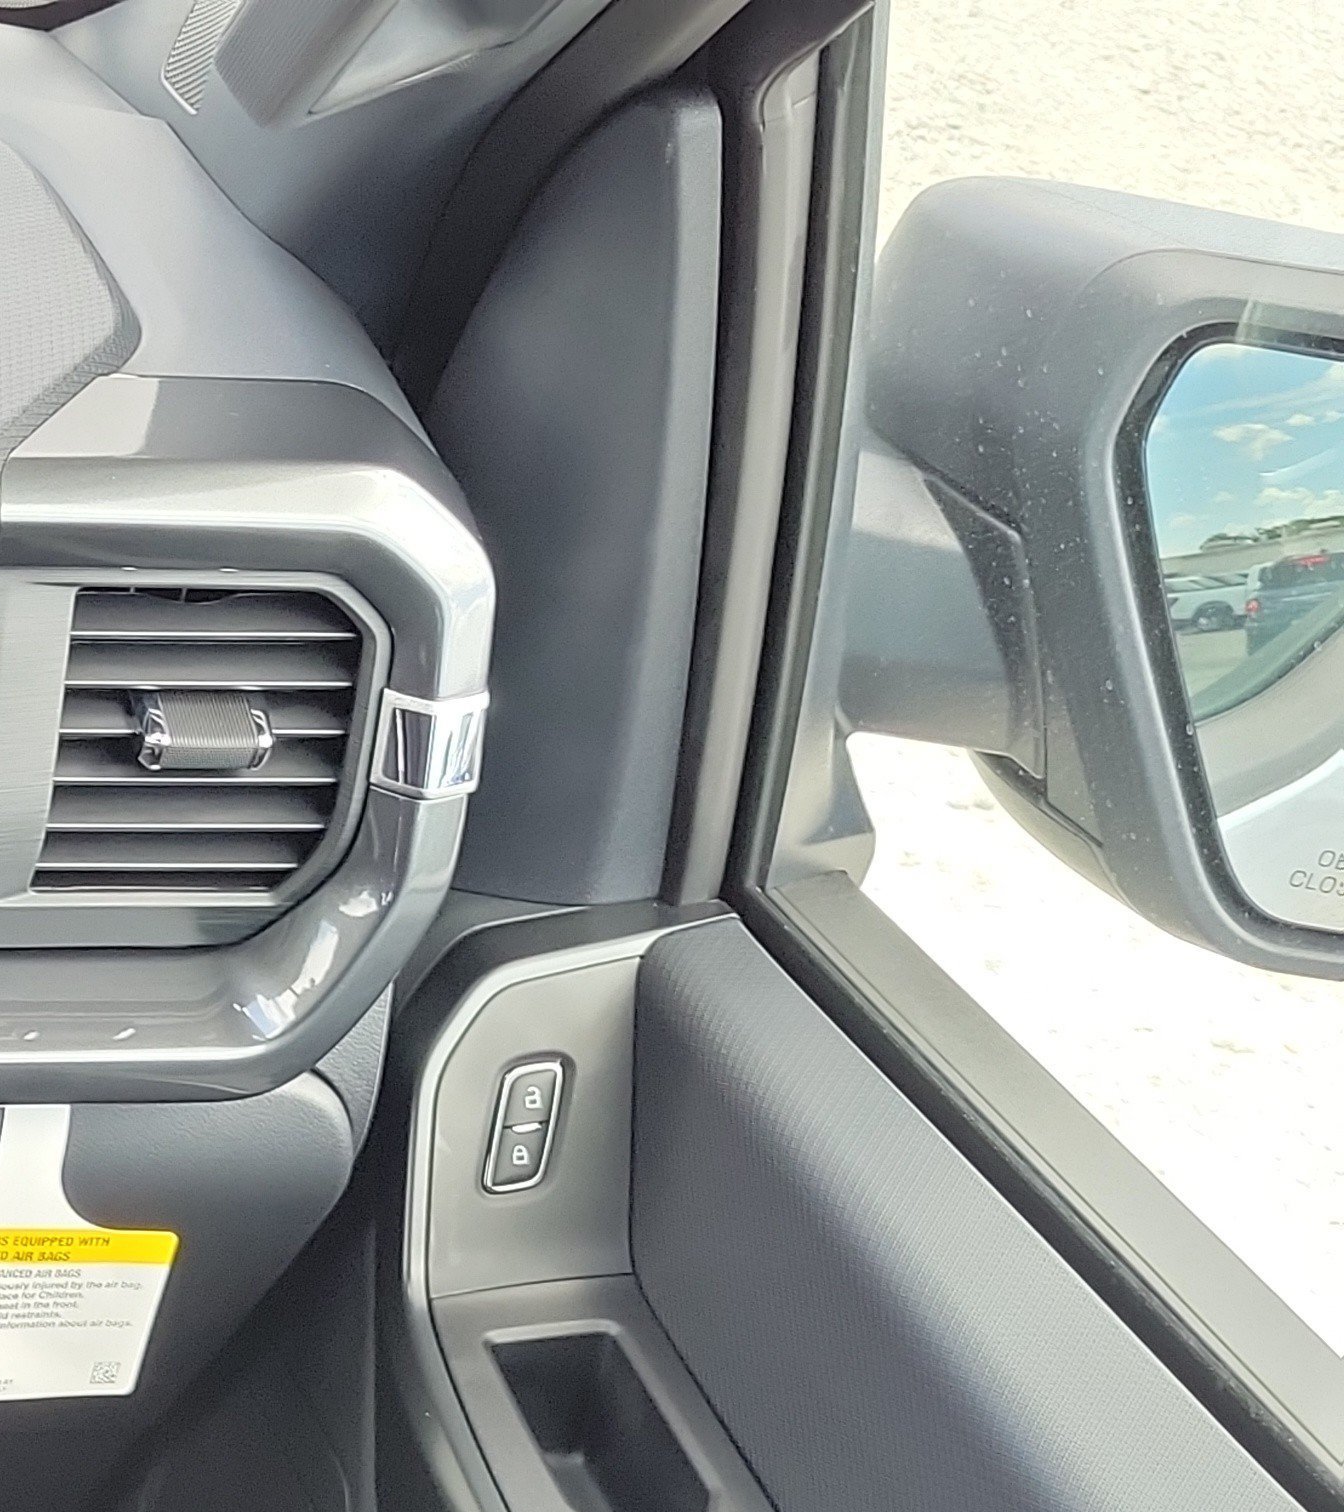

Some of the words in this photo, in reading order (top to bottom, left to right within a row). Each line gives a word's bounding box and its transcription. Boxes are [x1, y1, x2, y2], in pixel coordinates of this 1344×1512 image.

[13, 1236, 74, 1247] EQUIPPED
[79, 1236, 111, 1247] WITH
[13, 1251, 33, 1262] AIR
[37, 1251, 71, 1262] BAGS
[34, 1269, 53, 1279] AIR
[55, 1269, 82, 1279] BAGS
